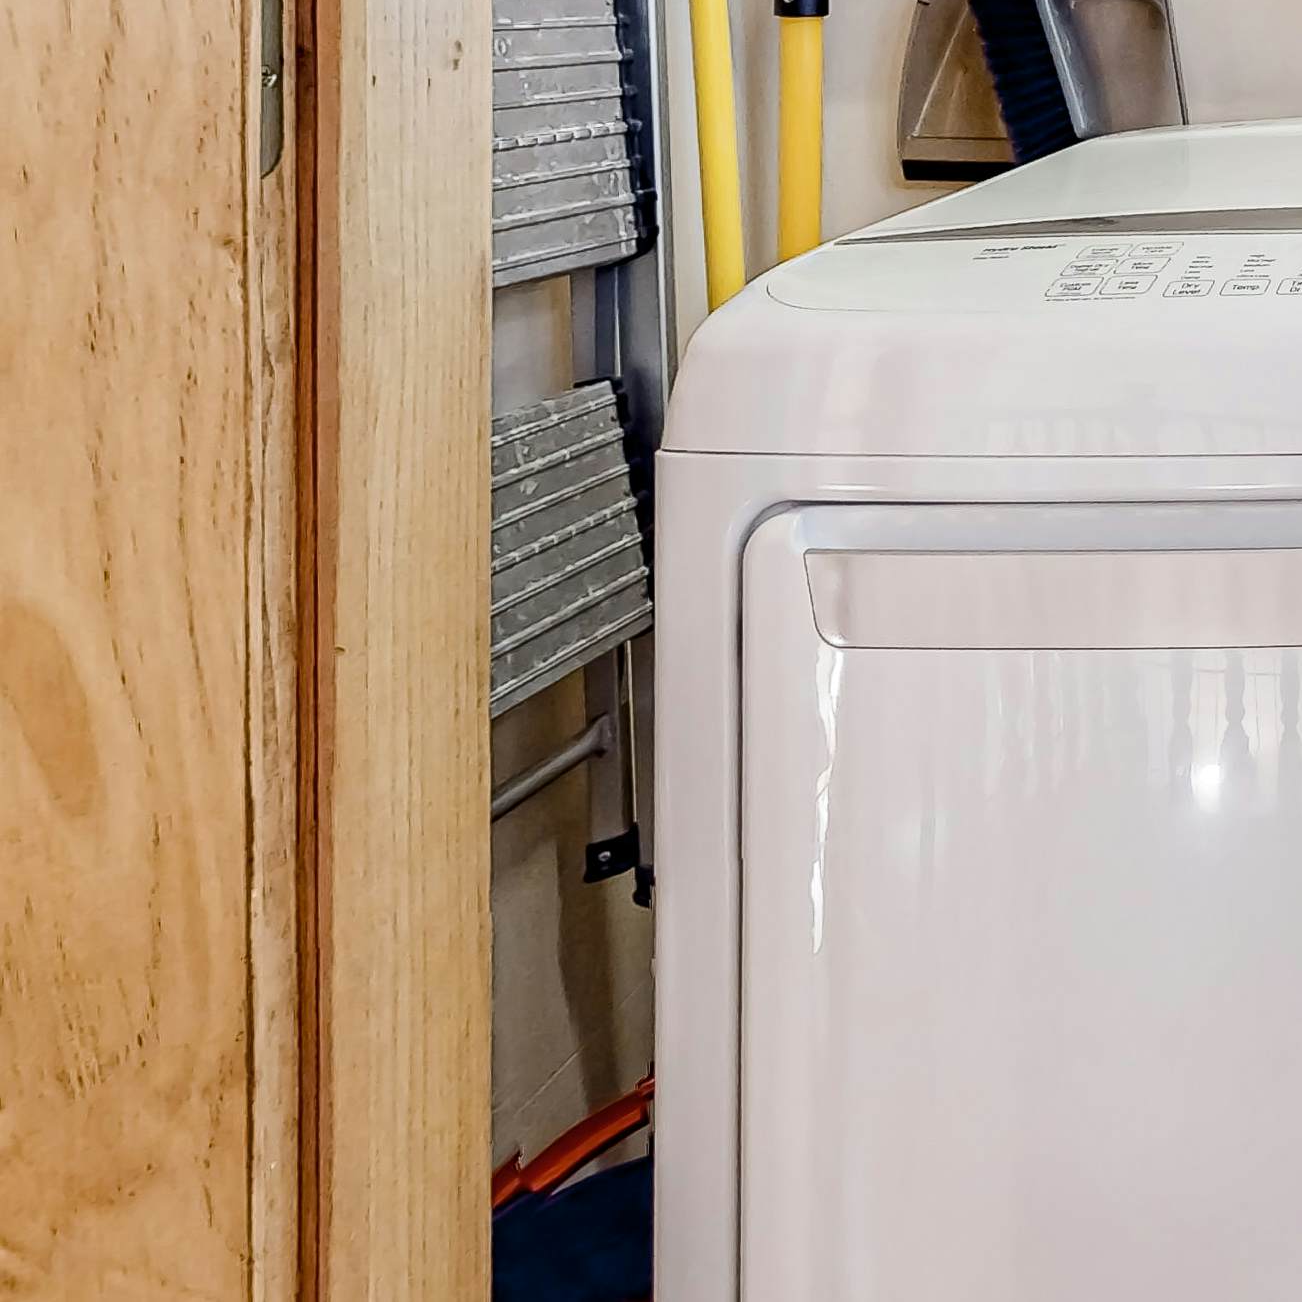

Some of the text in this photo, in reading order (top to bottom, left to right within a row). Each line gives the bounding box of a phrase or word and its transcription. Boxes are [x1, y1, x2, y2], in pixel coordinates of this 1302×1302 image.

[1181, 282, 1200, 290] Dry
[1231, 284, 1260, 292] Temp
[1172, 288, 1201, 296] Level
